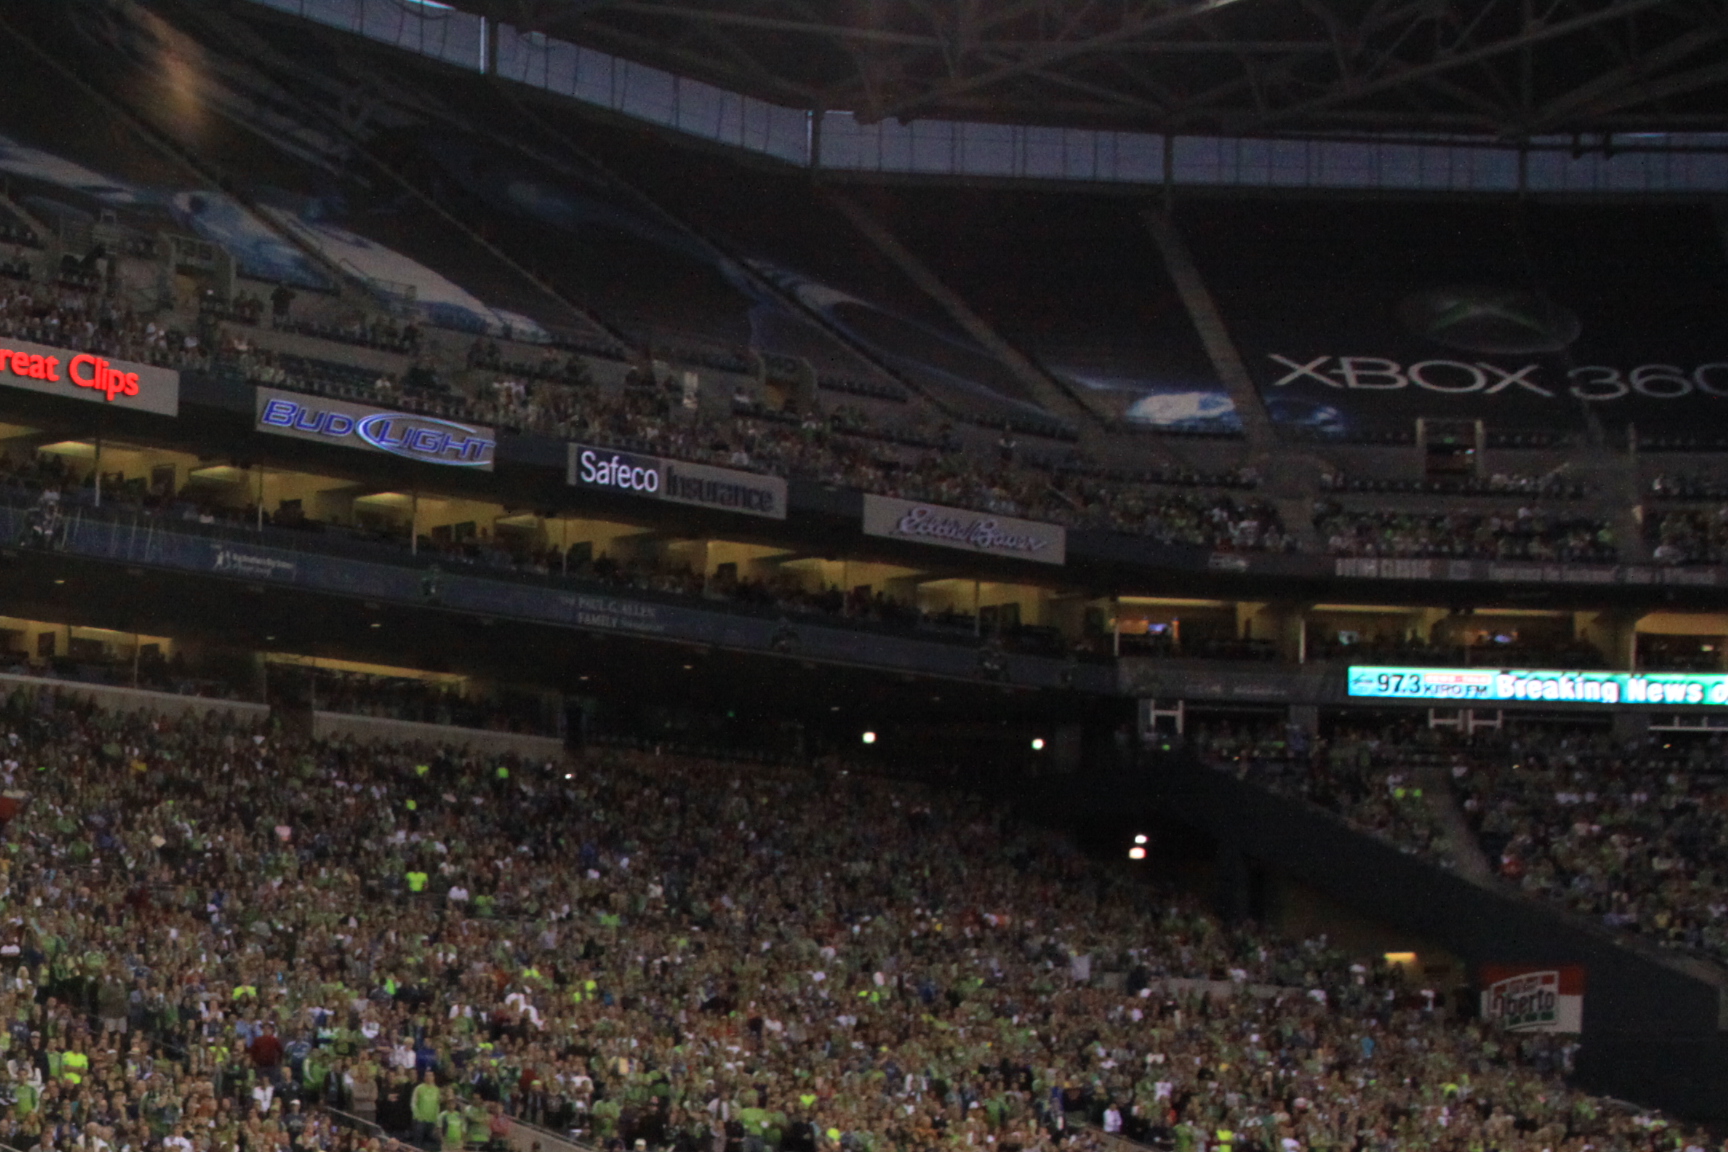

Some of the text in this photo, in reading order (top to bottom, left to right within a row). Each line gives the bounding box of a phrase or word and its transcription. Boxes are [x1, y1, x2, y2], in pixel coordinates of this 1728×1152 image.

[68, 354, 140, 401] Clips
[1268, 354, 1554, 397] XBOX
[262, 399, 497, 460] BUD LIGHT
[580, 450, 773, 513] Safeco Insurance
[1377, 673, 1421, 693] 97.3
[1496, 674, 1620, 703] Breaking
[1627, 677, 1704, 703] News
